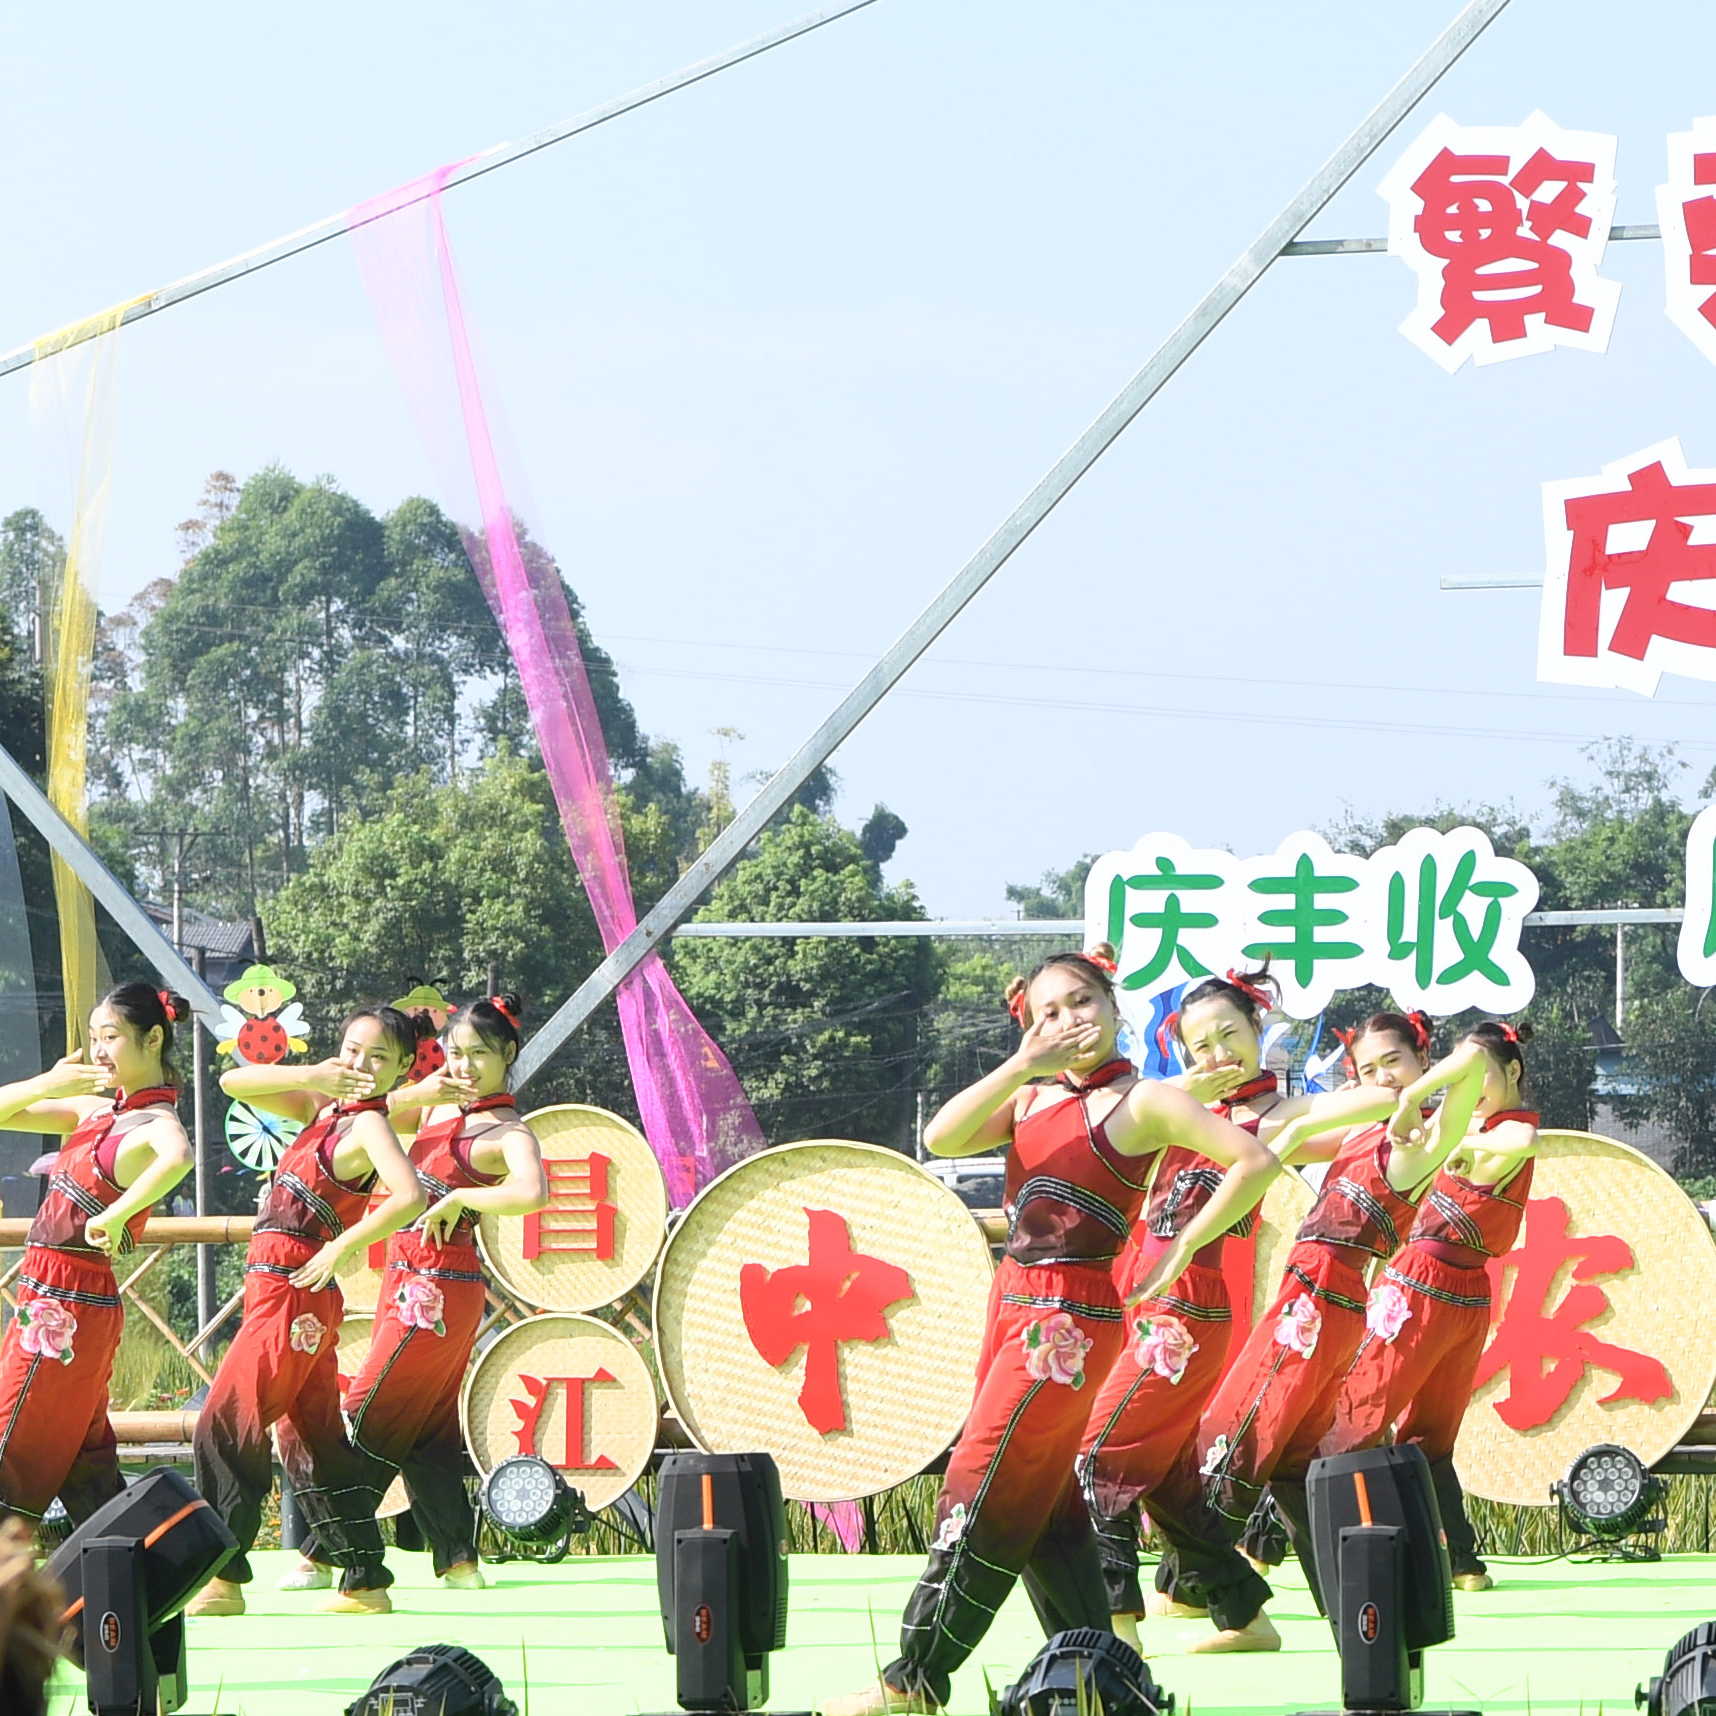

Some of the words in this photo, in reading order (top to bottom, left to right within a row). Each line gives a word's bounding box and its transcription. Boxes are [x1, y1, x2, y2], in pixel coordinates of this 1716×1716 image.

[1107, 851, 1517, 990] 庆丰收
[522, 1151, 618, 1260] 昌
[739, 1207, 915, 1435] 中
[1474, 1196, 1673, 1431] 农
[509, 1367, 620, 1470] 江
[1367, 1607, 1375, 1639] BEAM
